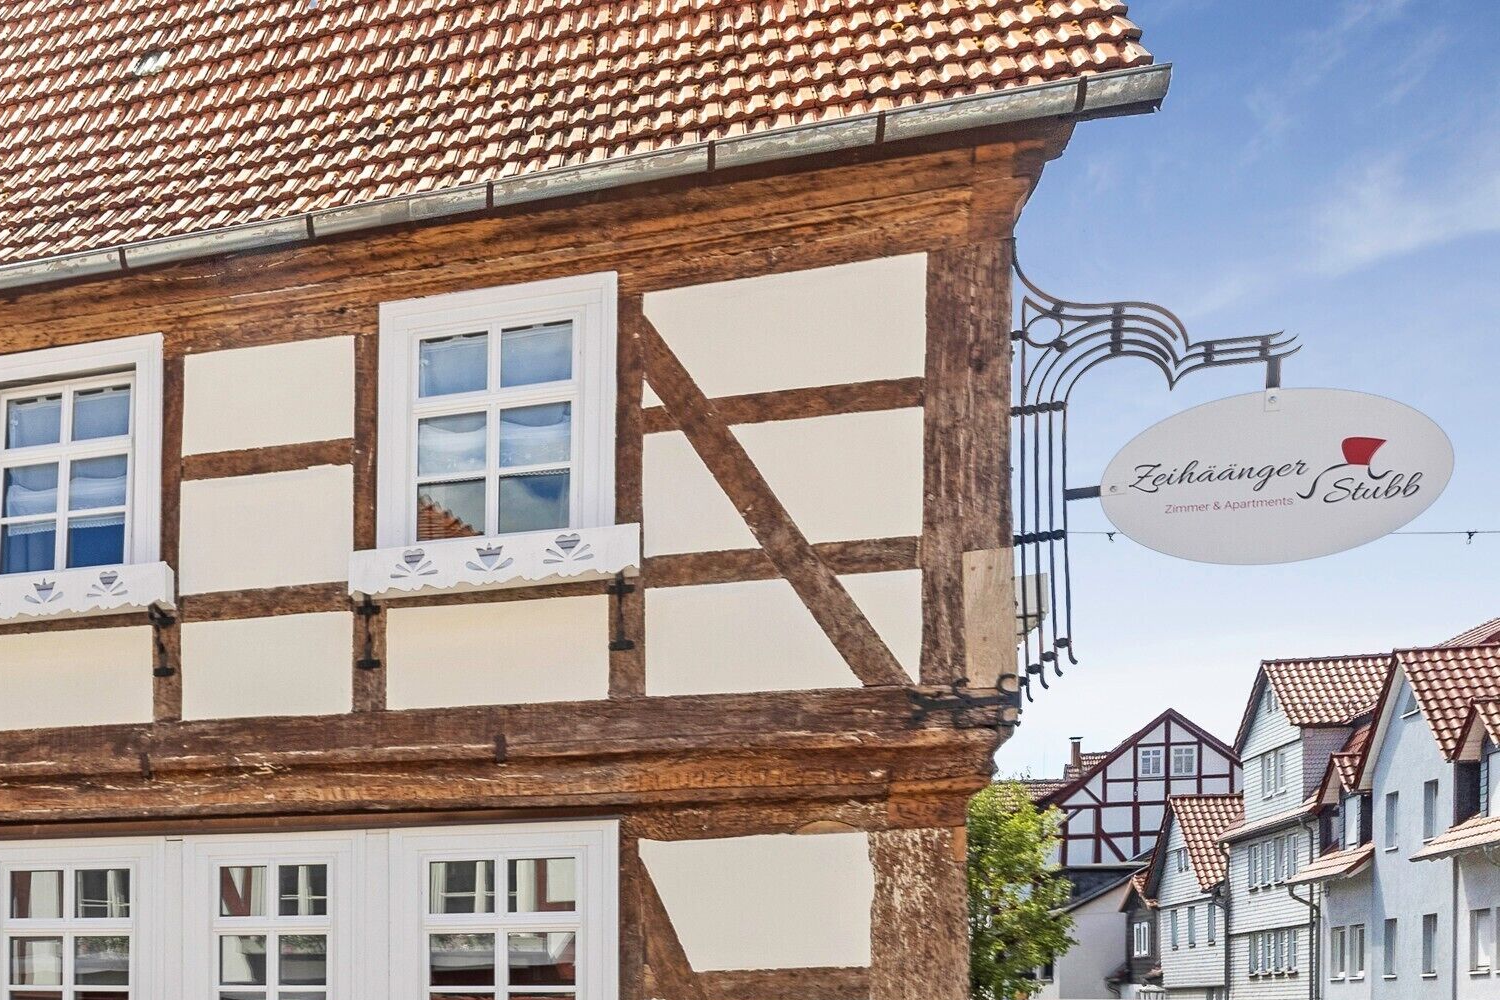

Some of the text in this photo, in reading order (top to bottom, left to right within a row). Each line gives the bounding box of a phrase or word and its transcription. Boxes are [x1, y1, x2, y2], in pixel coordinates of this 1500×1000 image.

[1128, 459, 1423, 503] Zeihäänger Stubb
[1165, 496, 1294, 514] Zimmer & Apartments
